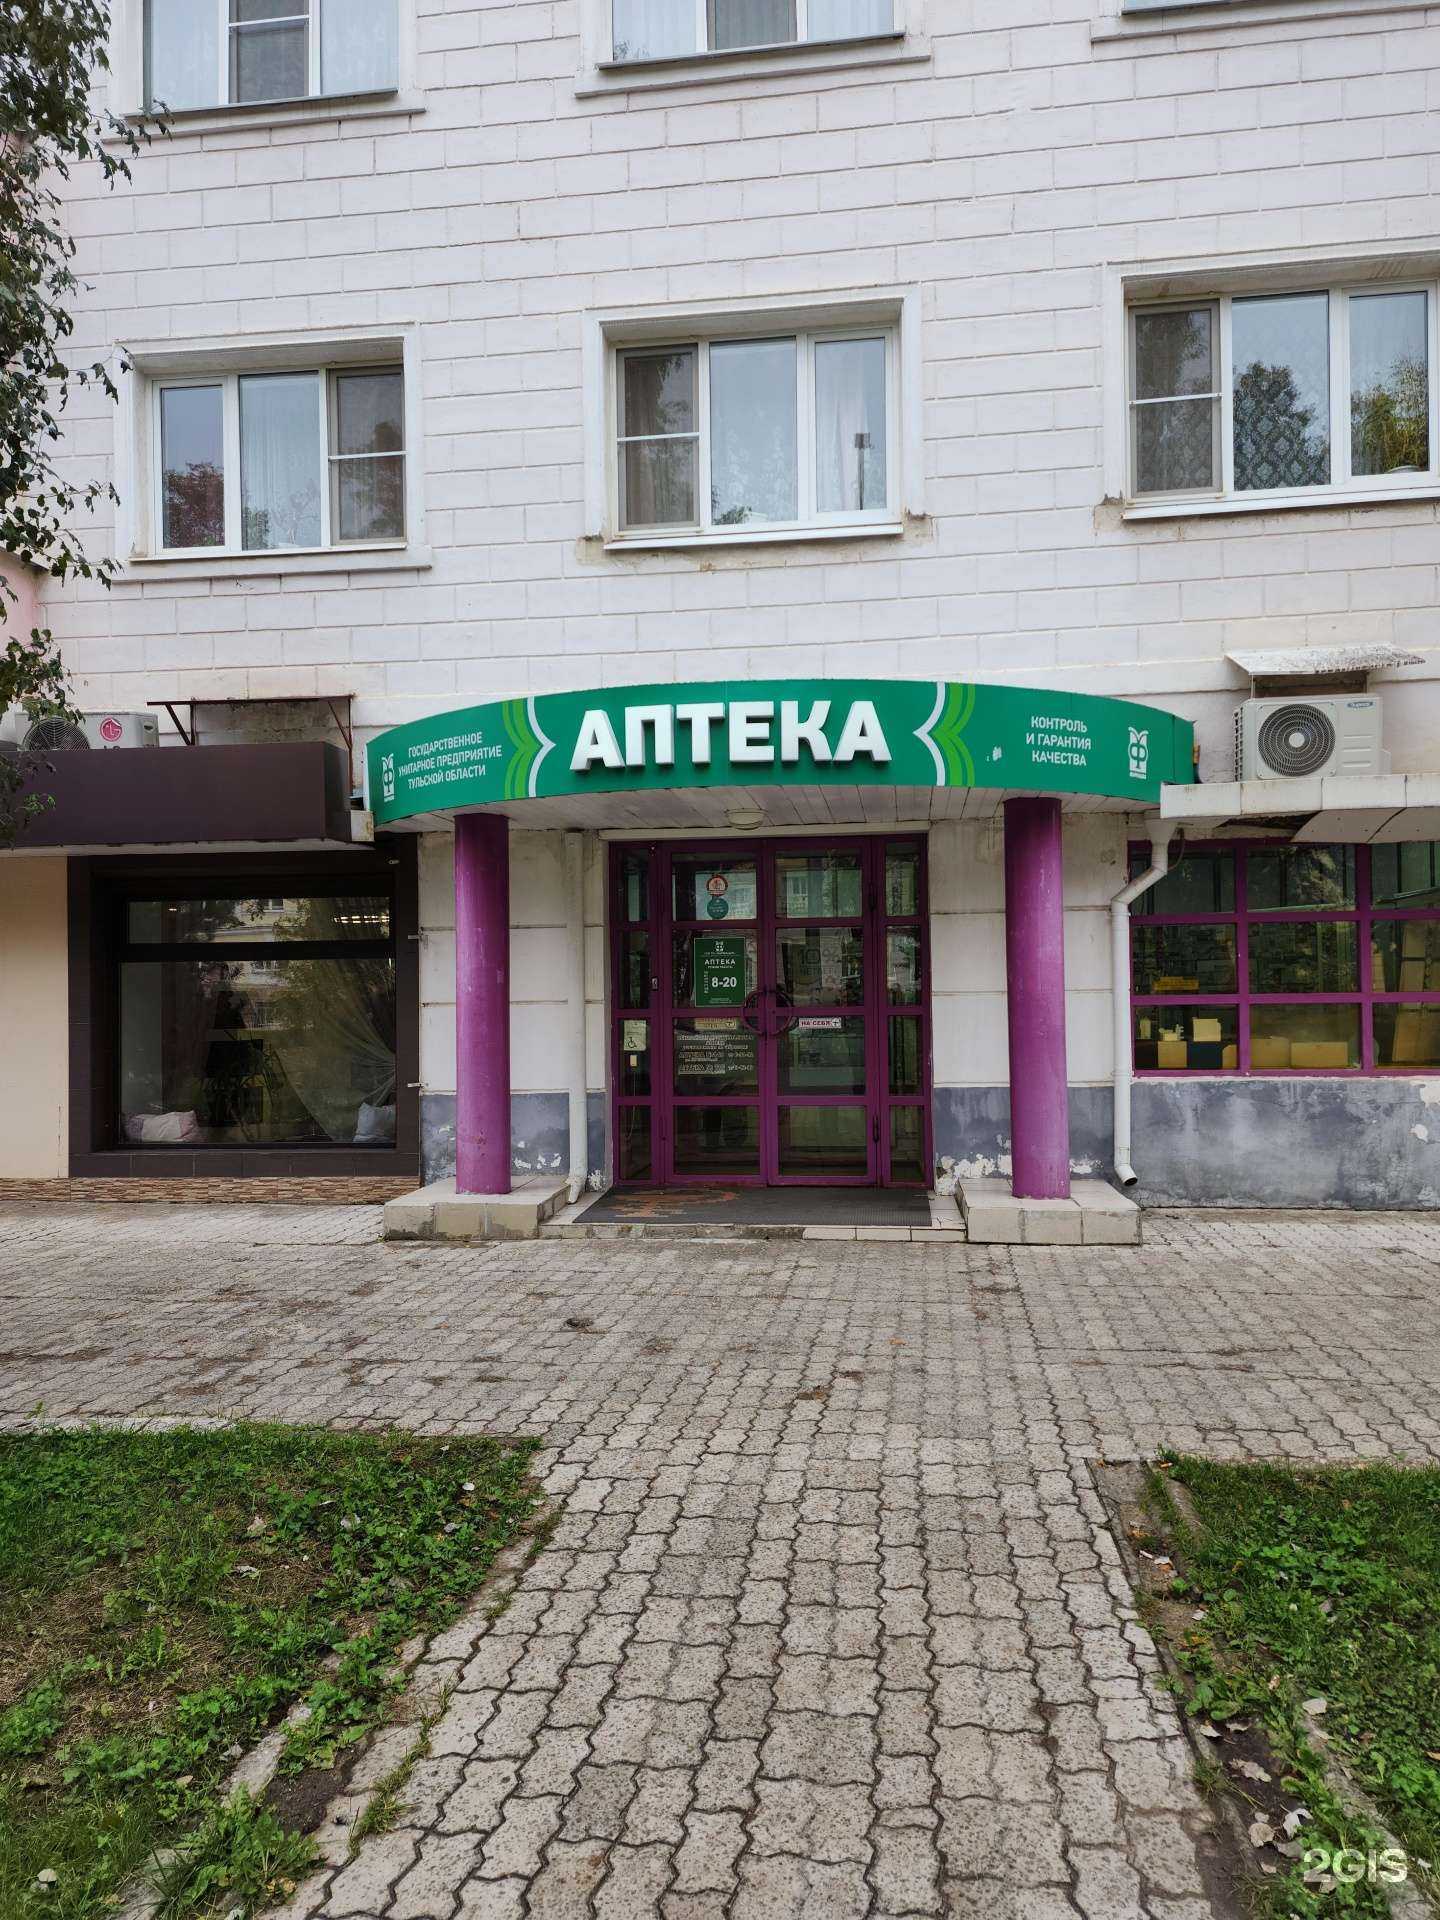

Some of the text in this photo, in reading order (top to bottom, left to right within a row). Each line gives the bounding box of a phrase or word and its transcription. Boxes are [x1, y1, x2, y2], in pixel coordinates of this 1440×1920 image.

[1031, 716, 1088, 733] КОНТРОЛЬ
[408, 732, 483, 758] ГОСУДАРСТВЕННОЕ
[569, 700, 892, 771] АПТЕКА
[1026, 733, 1092, 750] И ГАРАНТИЯ
[398, 745, 502, 777] УНИТАРНОЕ ПРЕДПРИЯТИЕ
[1032, 750, 1086, 766] КАЧЕСТВА
[407, 764, 486, 789] ТУЛЬСКОЙ ОБЛАСТИ
[711, 976, 737, 988] 8-20
